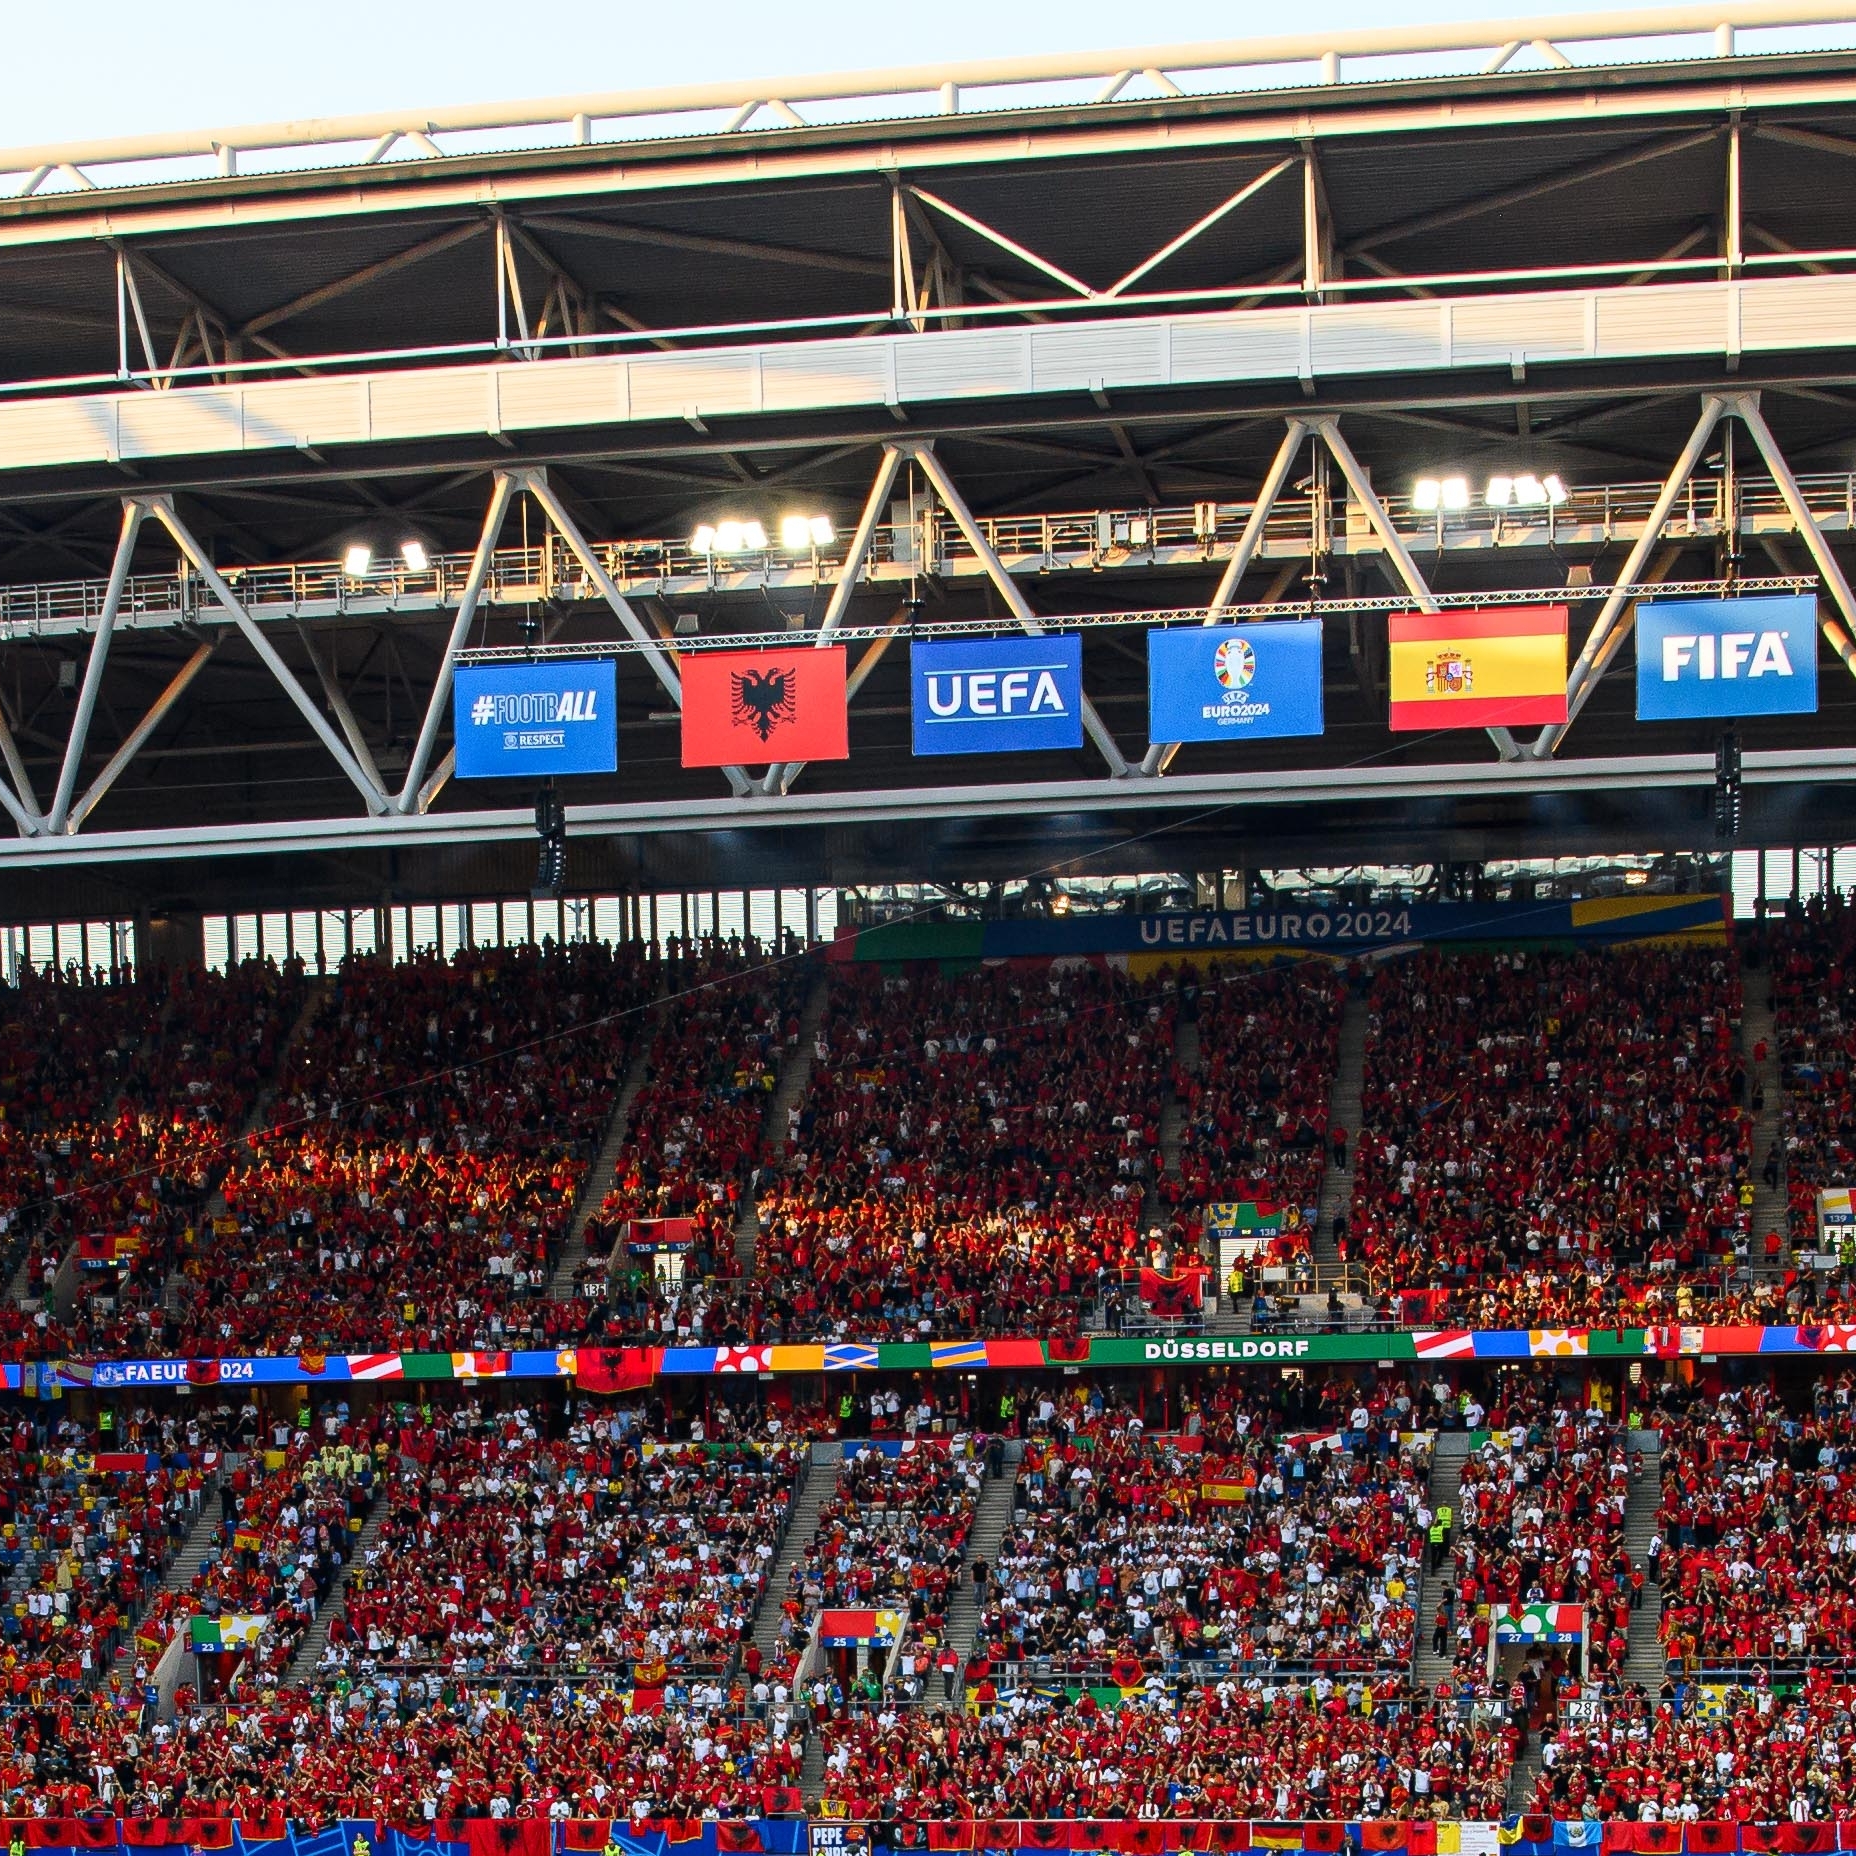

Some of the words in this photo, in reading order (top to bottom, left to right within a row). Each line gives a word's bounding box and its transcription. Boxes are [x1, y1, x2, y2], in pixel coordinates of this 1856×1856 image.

[1662, 631, 1793, 682] FIFA
[927, 671, 1064, 717] UEFA
[471, 690, 597, 725] #FOOTBALL
[1202, 703, 1271, 719] EURO2024
[519, 733, 565, 747] RESPECT
[1144, 1338, 1310, 1359] DÜSSELDORF
[1575, 1702, 1593, 1716] 28
[812, 1827, 843, 1846] PEPE
